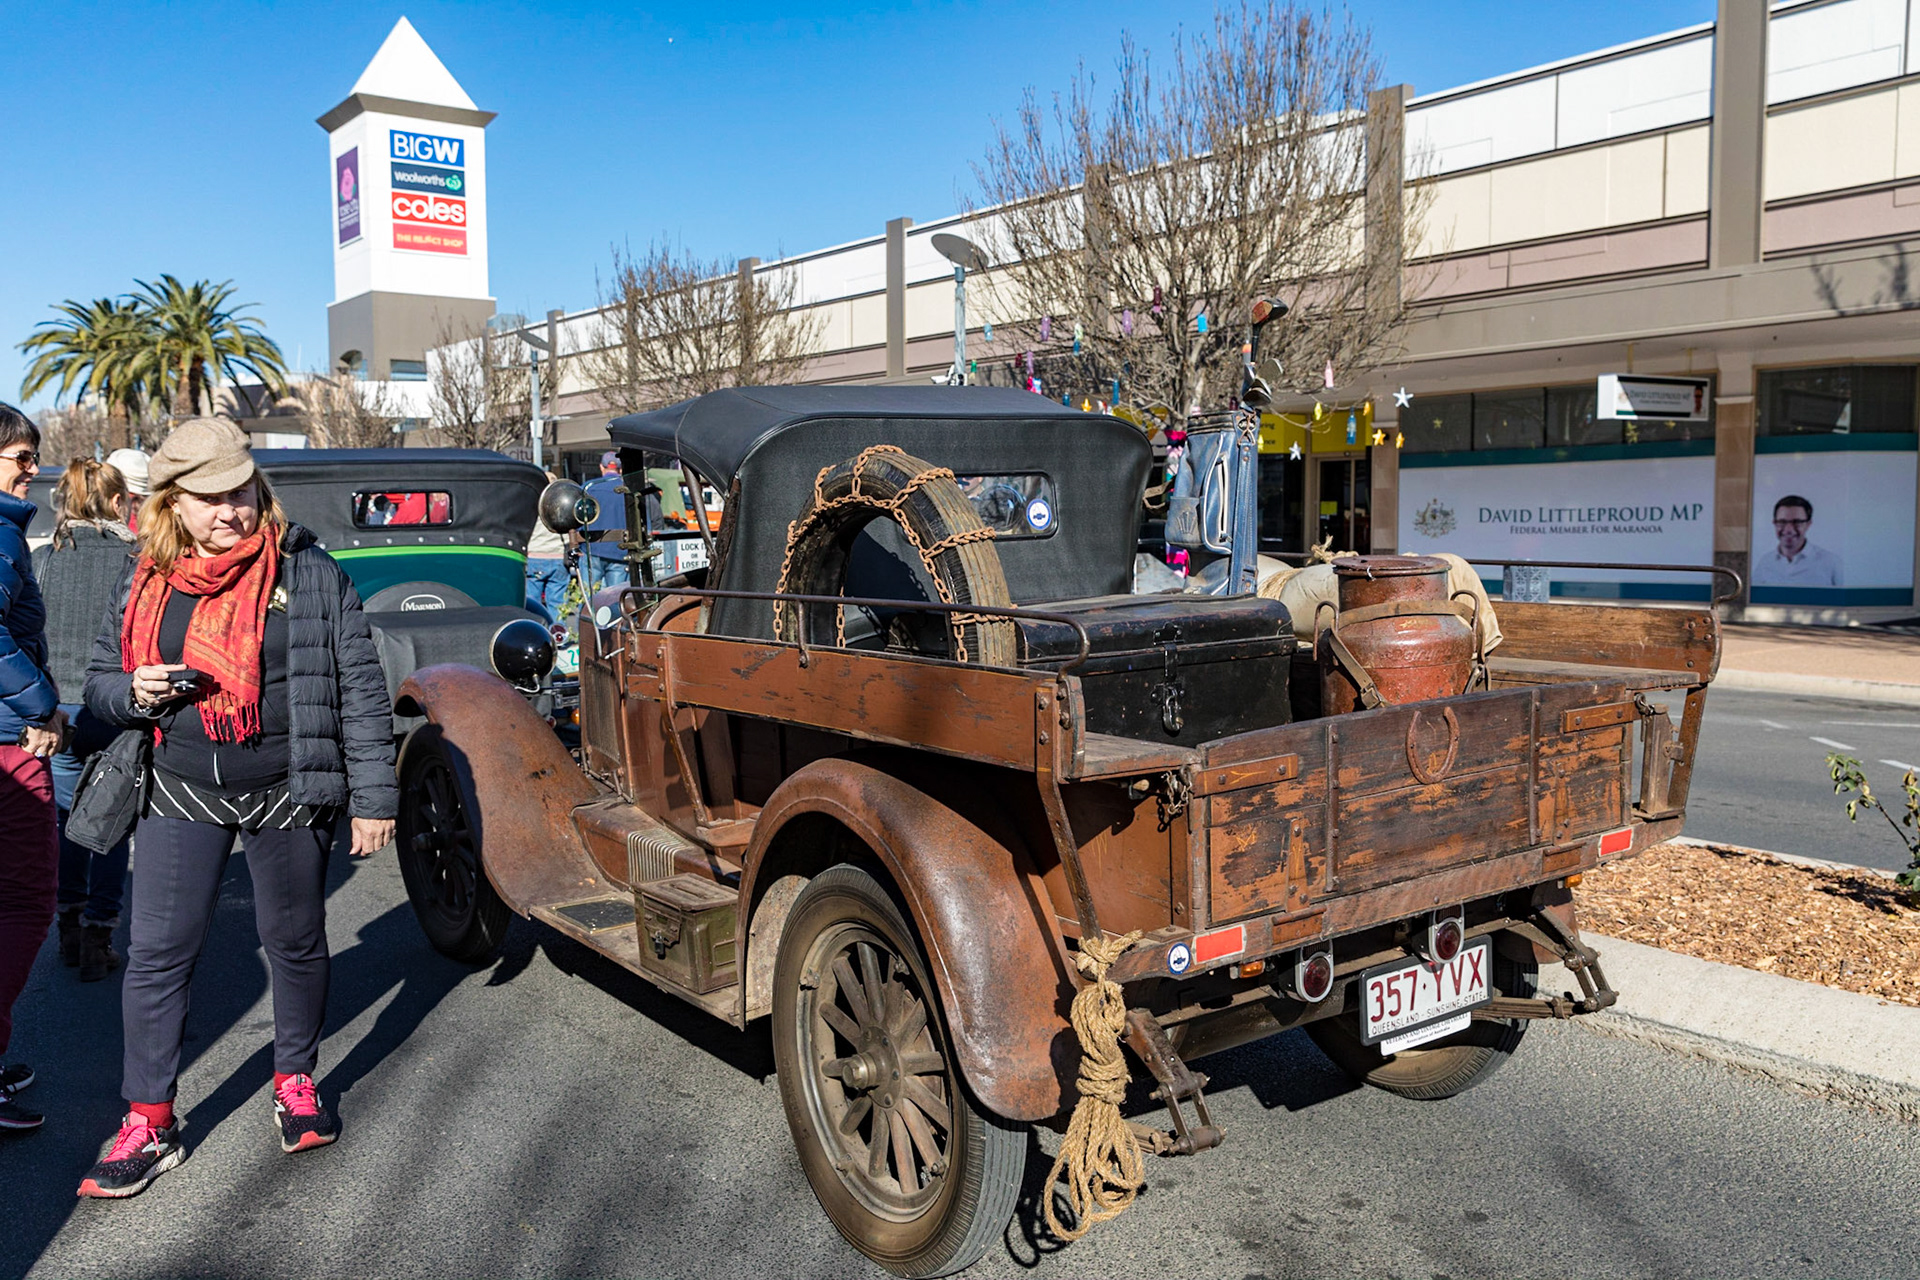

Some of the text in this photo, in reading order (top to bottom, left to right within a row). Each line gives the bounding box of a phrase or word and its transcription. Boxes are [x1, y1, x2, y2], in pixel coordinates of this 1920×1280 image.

[394, 171, 446, 187] Woolworths
[393, 195, 465, 223] coles
[1670, 503, 1704, 521] MP
[681, 543, 699, 551] LOCK
[1371, 1012, 1419, 1036] QUEENSLAND
